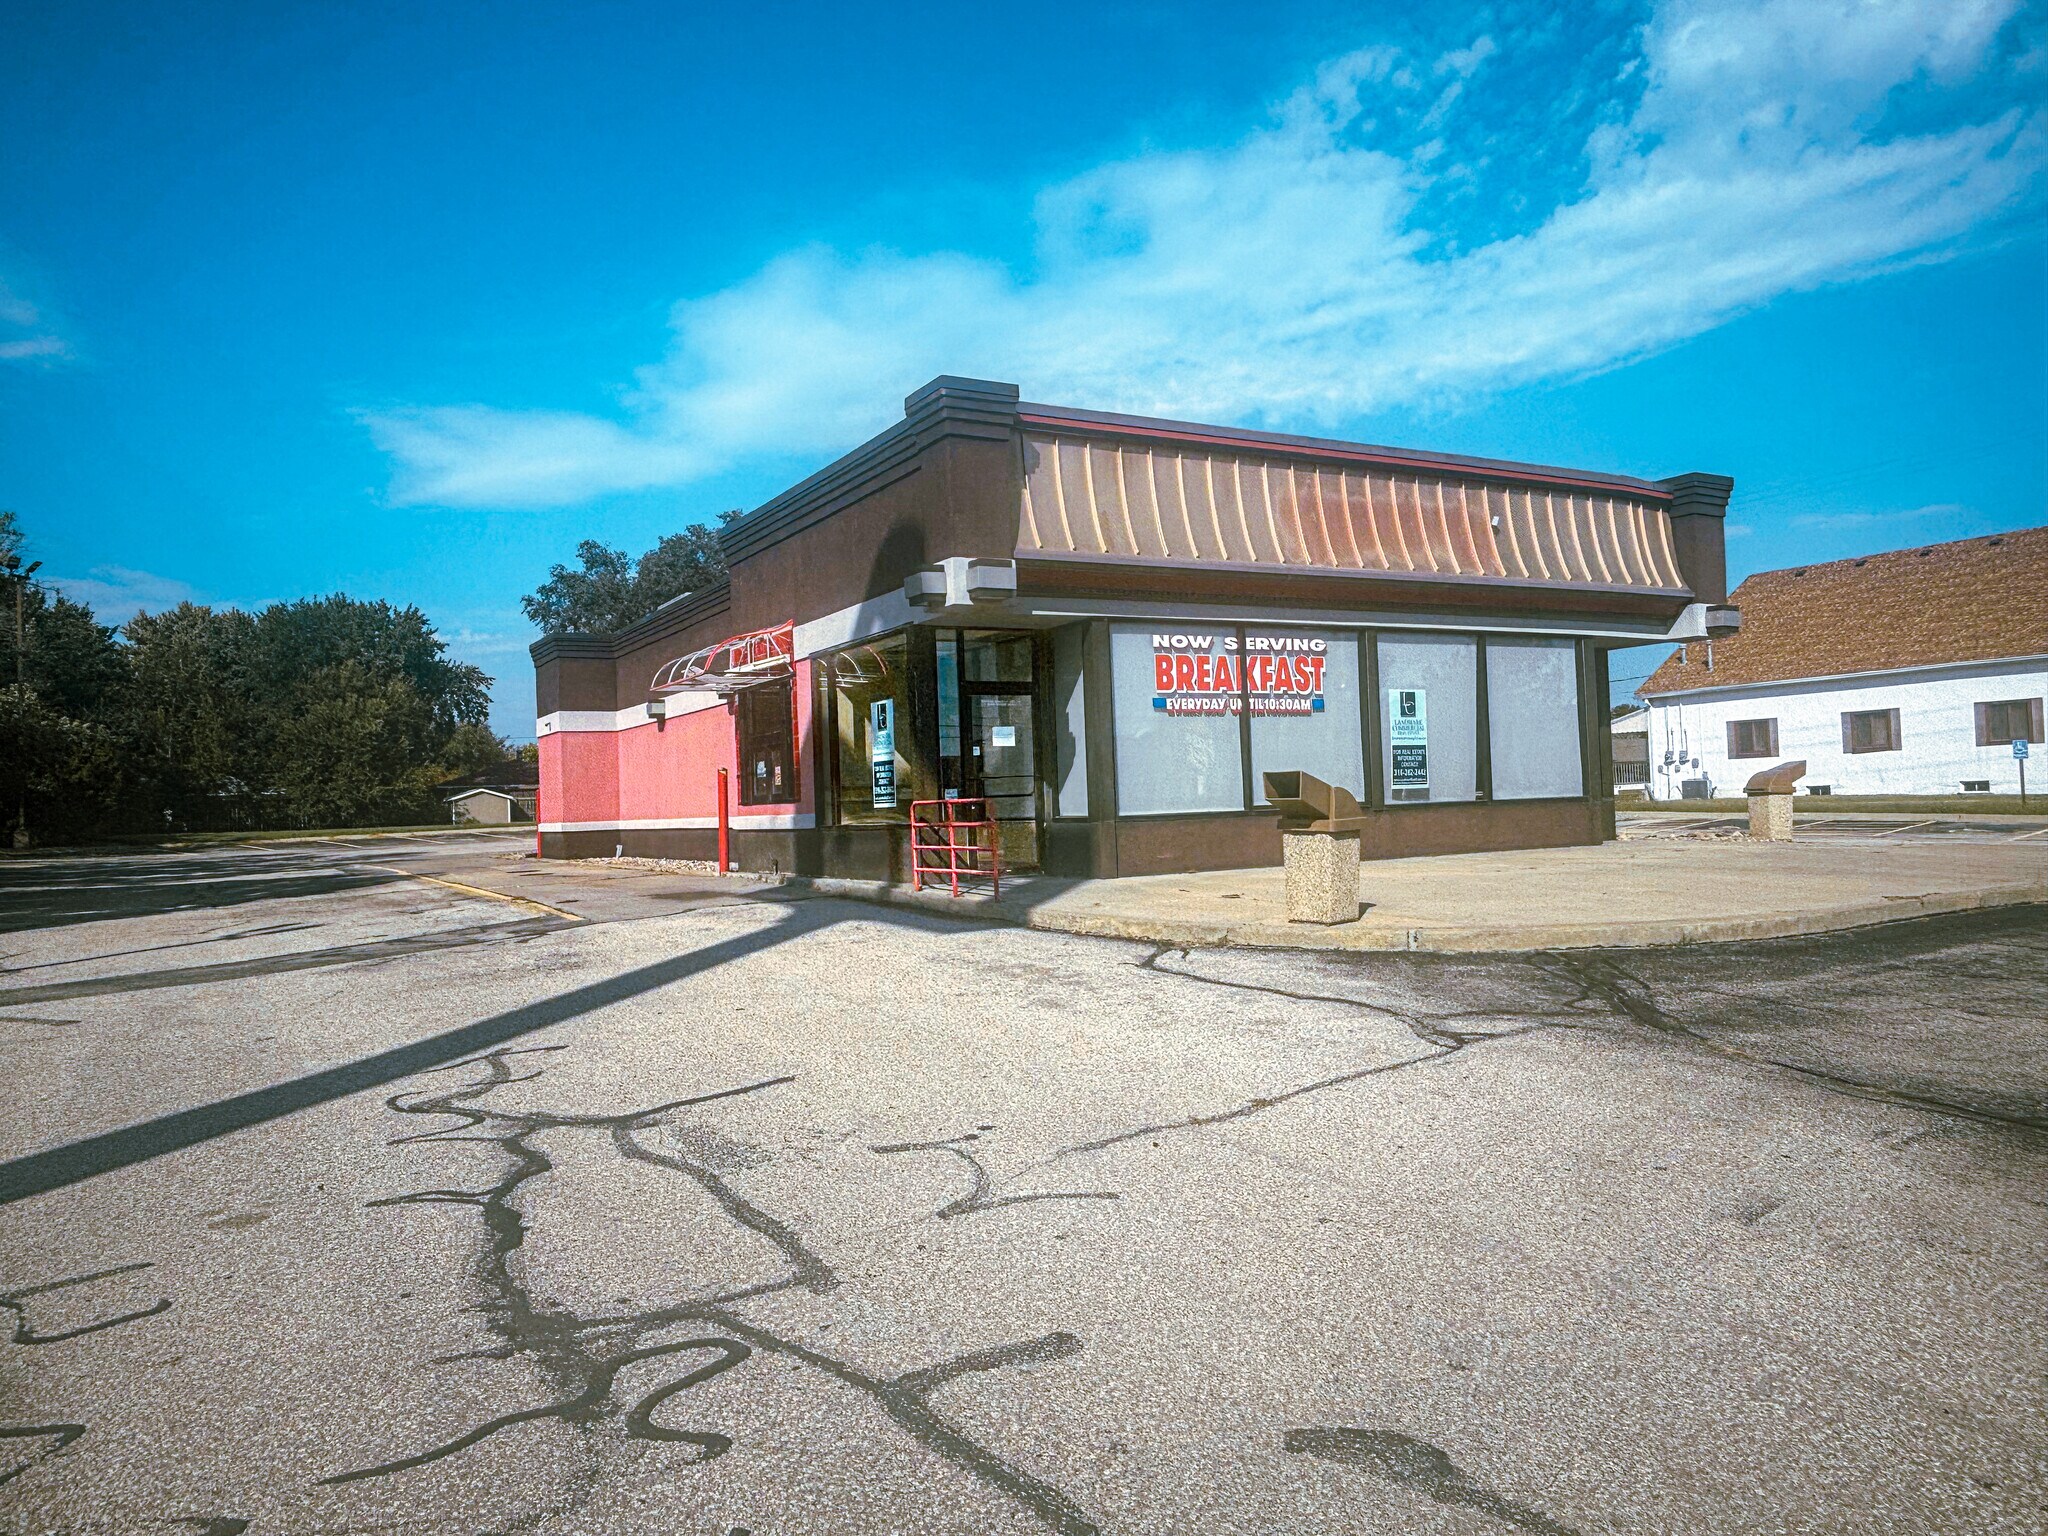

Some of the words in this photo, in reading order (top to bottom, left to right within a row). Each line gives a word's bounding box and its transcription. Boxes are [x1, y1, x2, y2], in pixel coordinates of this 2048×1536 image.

[1152, 634, 1213, 650] NOW
[1224, 636, 1327, 652] SERVING
[1154, 653, 1326, 695] BREAKFAST
[1166, 697, 1226, 711] EVERYDAY
